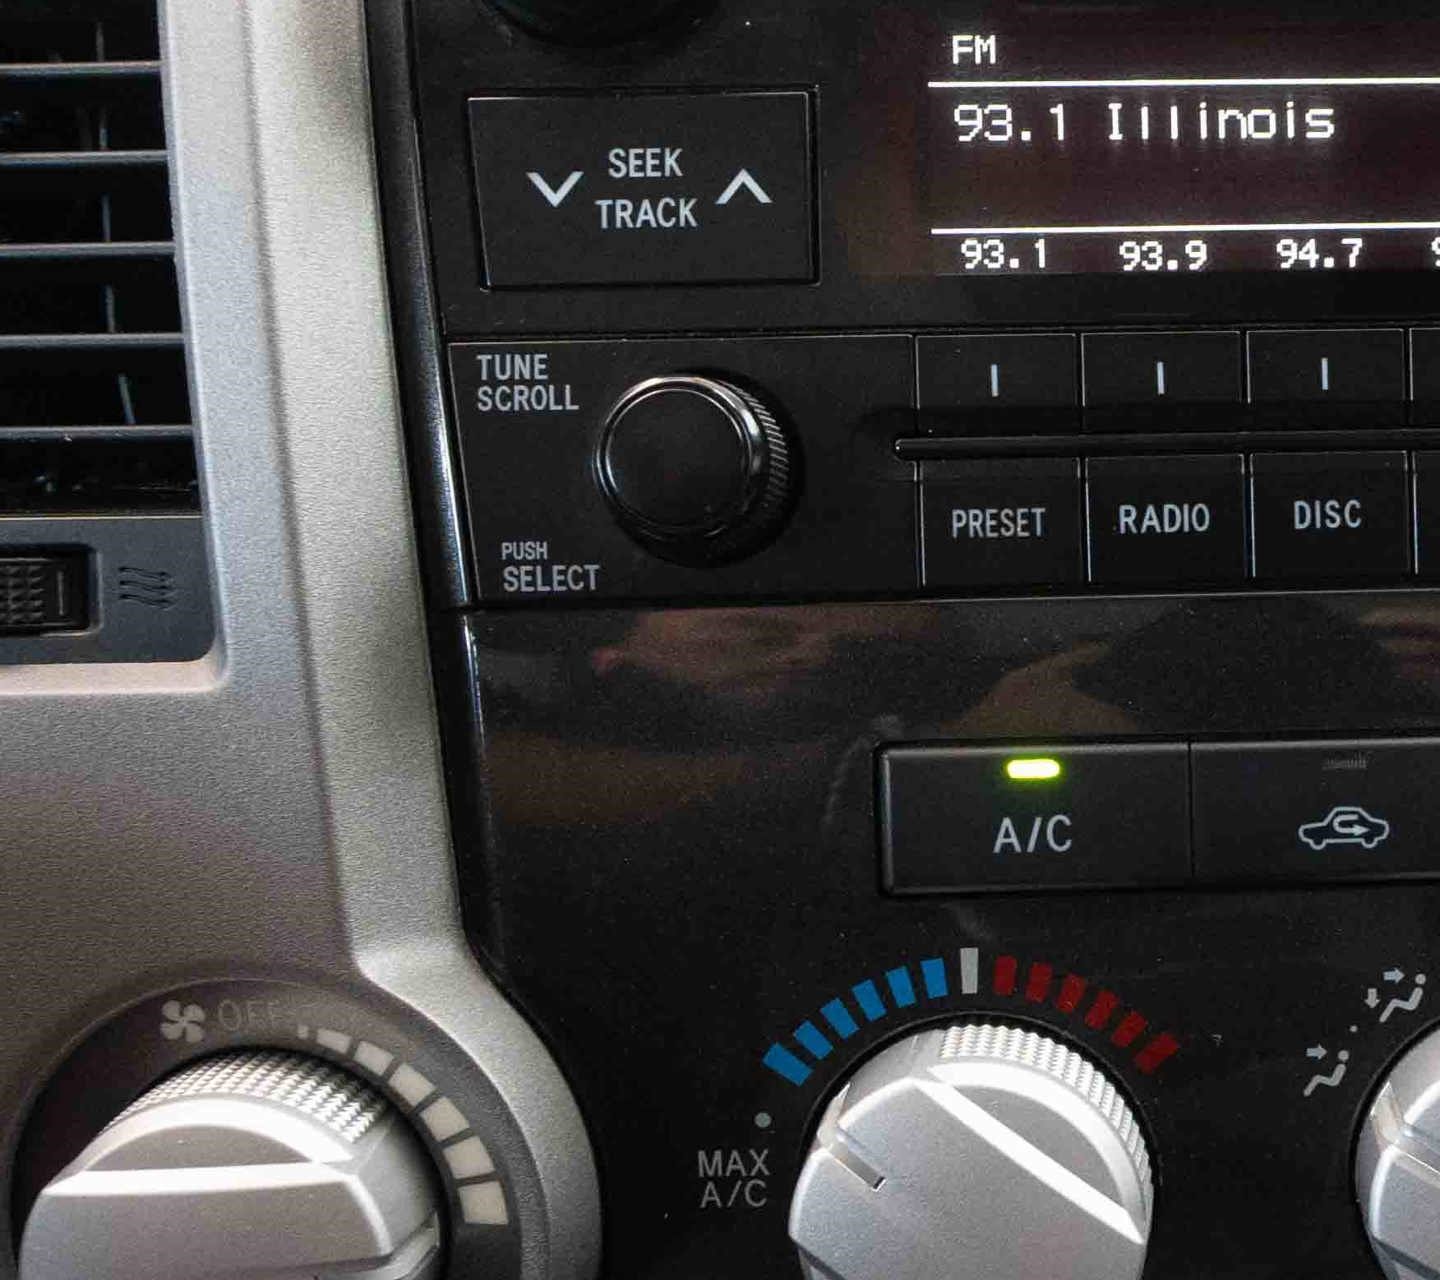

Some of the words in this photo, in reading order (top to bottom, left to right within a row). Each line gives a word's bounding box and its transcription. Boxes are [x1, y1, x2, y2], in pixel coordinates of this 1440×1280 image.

[951, 34, 997, 65] FM
[953, 103, 1065, 142] 93.1
[1108, 100, 1335, 141] Illinois
[608, 147, 683, 179] SEEK
[594, 197, 698, 229] TRACK
[960, 237, 1046, 270] 93.1
[1118, 239, 1208, 272] 93.9
[1275, 237, 1363, 269] 94.7
[476, 353, 549, 381] TUNE
[477, 384, 580, 412] SCROLL
[952, 507, 1046, 538] PRESET
[1119, 503, 1210, 535] RADIO
[1293, 499, 1362, 530] DISC
[501, 540, 548, 561] PUSH
[503, 564, 601, 592] SELECT
[993, 814, 1073, 854] A/C
[697, 1148, 771, 1178] MAX
[699, 1179, 768, 1209] A/C
